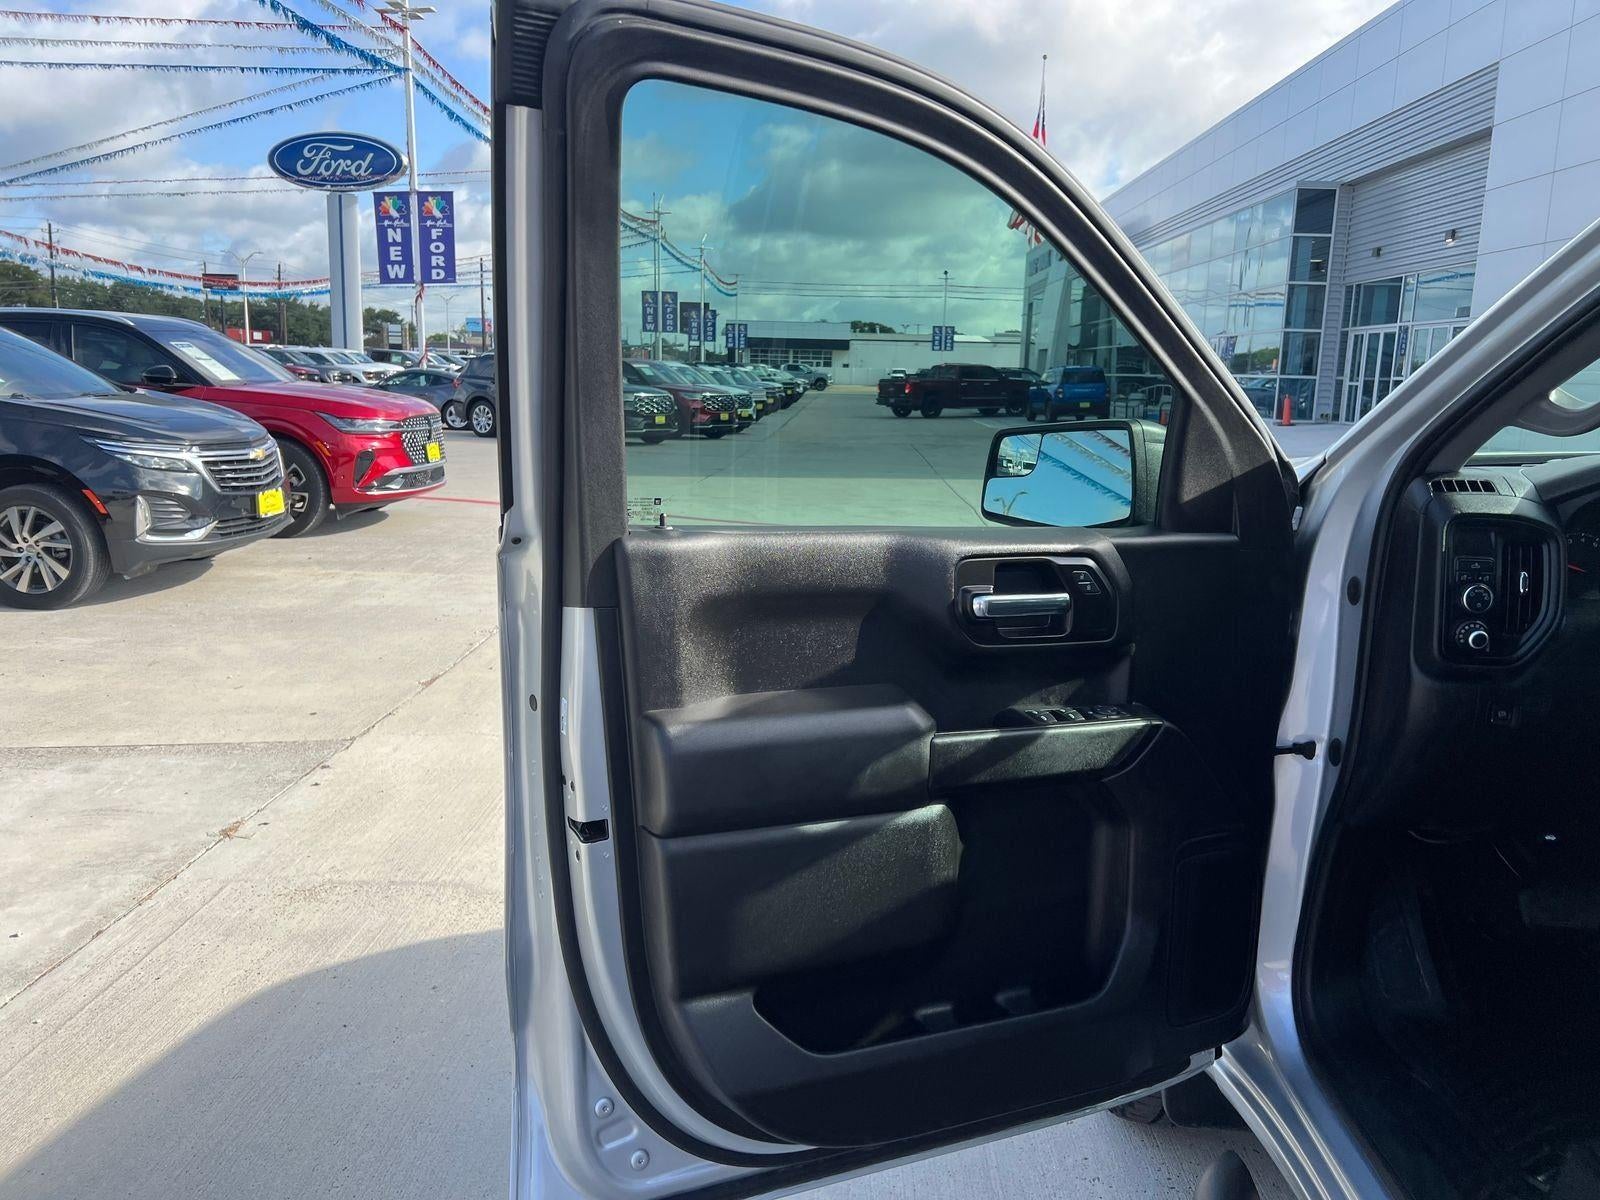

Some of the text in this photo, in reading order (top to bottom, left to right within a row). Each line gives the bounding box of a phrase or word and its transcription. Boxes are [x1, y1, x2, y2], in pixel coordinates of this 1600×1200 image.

[297, 142, 374, 177] Ford
[387, 228, 406, 279] NEW
[429, 228, 446, 280] FORD
[646, 307, 655, 330] NEW
[666, 307, 674, 331] FORD
[691, 322, 699, 340] NEW
